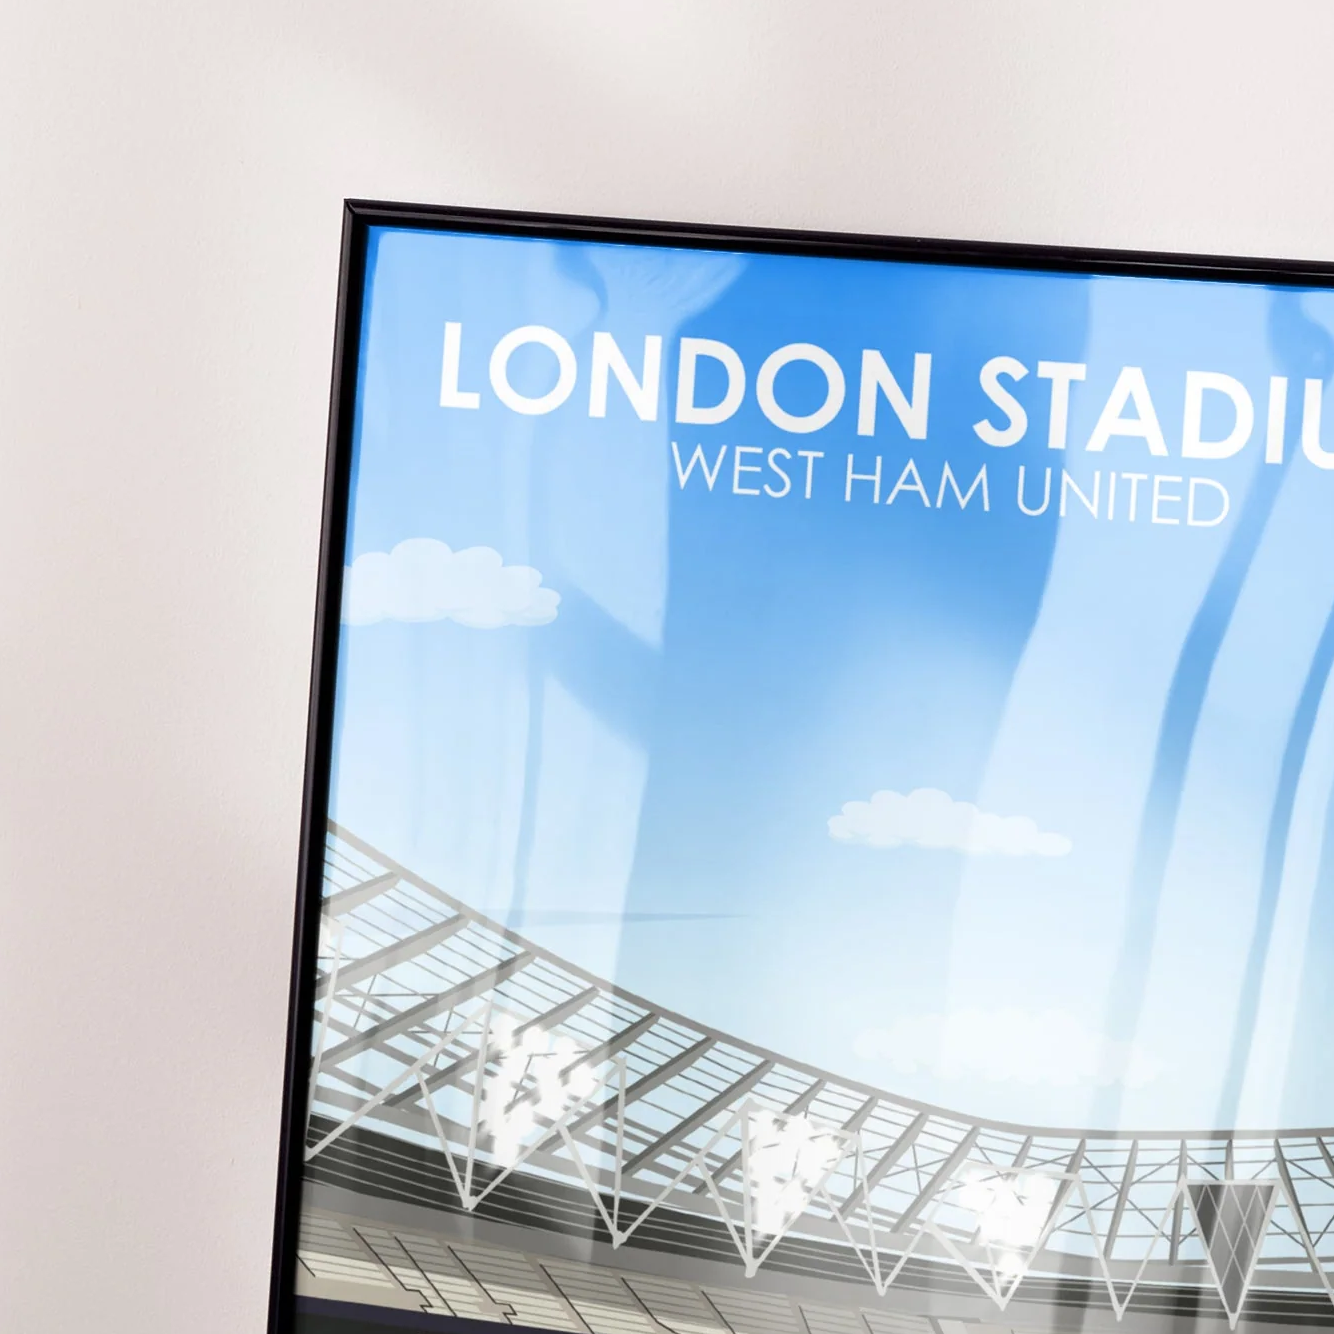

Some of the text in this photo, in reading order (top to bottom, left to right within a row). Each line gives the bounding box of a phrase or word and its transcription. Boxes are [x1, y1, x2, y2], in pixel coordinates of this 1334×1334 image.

[439, 321, 932, 440] LONDON
[670, 441, 1230, 527] WEST HAM UNITED
